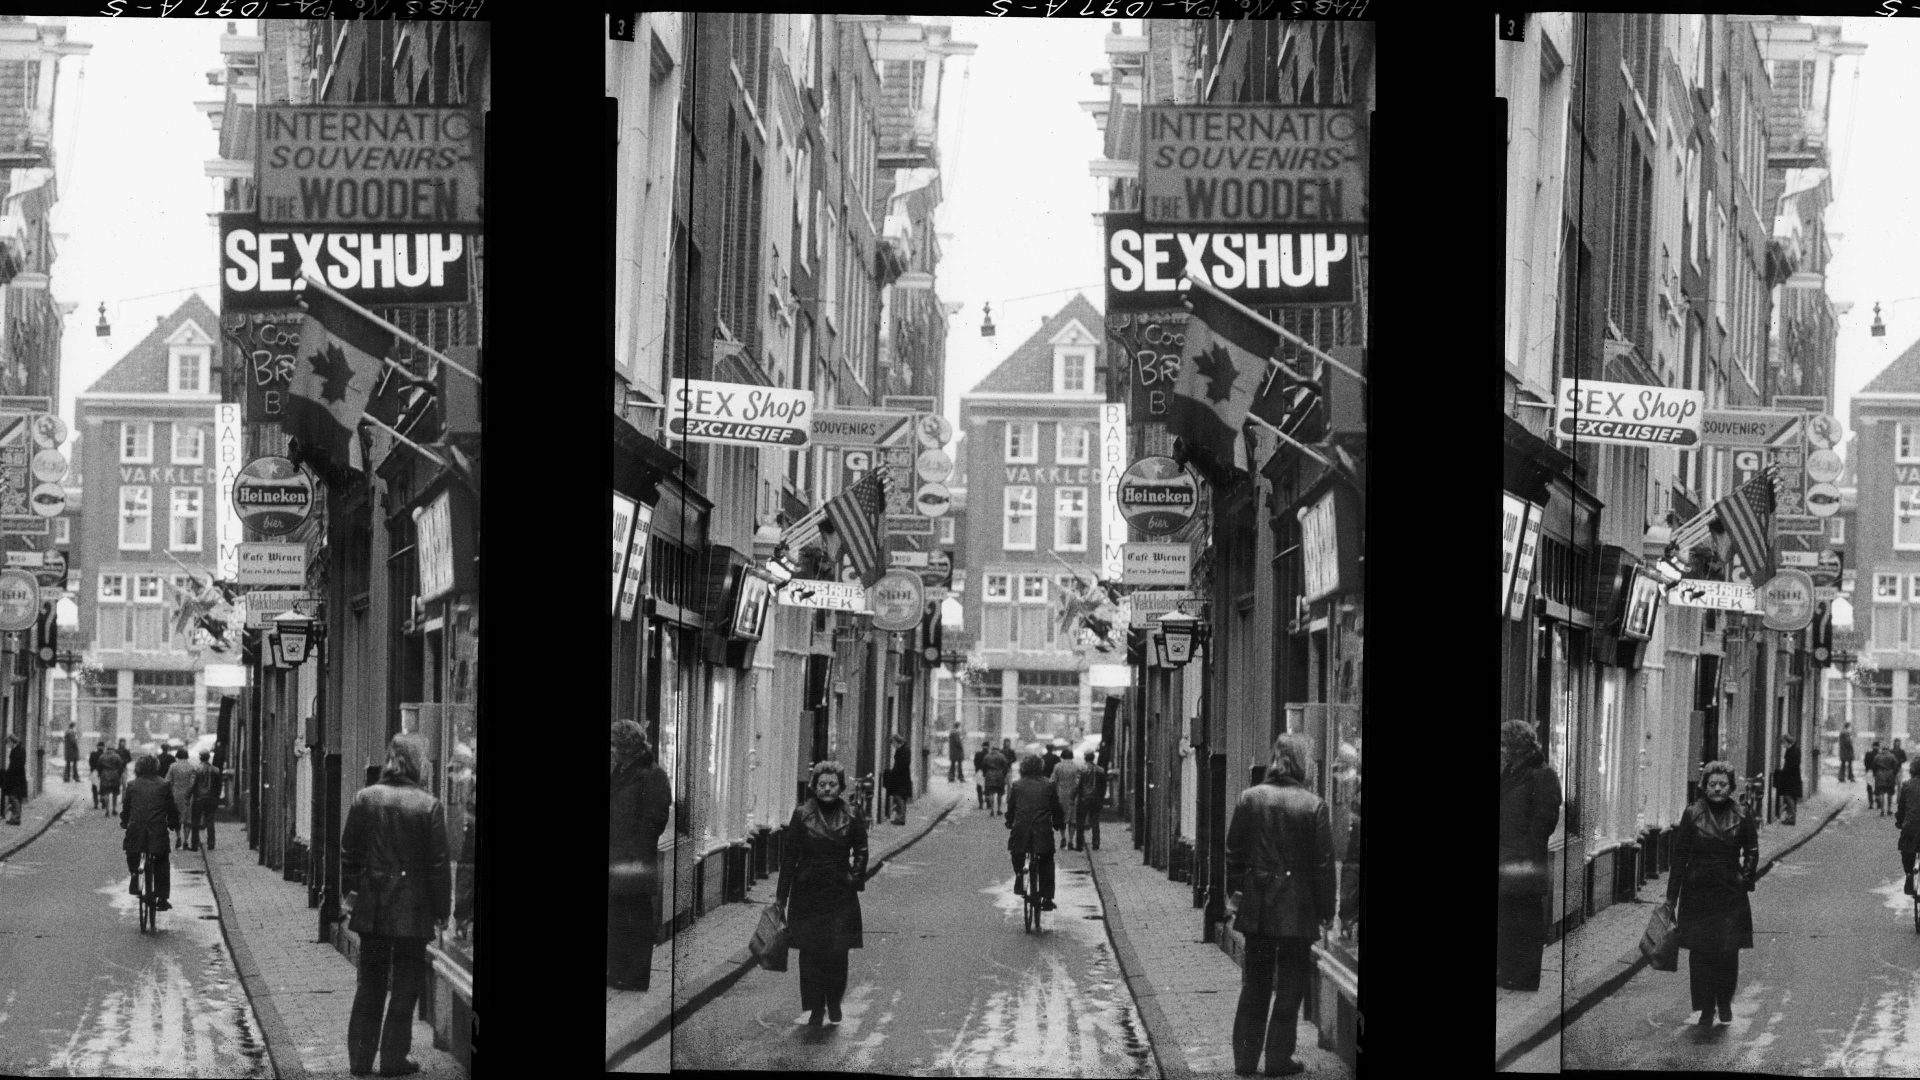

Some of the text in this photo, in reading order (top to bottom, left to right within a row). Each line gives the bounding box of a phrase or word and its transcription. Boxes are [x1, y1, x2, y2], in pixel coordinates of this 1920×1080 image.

[617, 19, 626, 36] 3
[1507, 19, 1516, 36] 3
[266, 176, 460, 220] THE WOODEN
[1151, 176, 1345, 220] THE WOODEN
[674, 388, 806, 423] SEX Shop
[1564, 388, 1696, 423] SEX Shop
[682, 420, 793, 443] EXCLUSIEF
[1572, 420, 1683, 443] EXCLUSIEF
[240, 487, 306, 503] Heineken
[1125, 487, 1191, 503] Heineken
[263, 515, 284, 529] bier
[1148, 515, 1169, 529] bier
